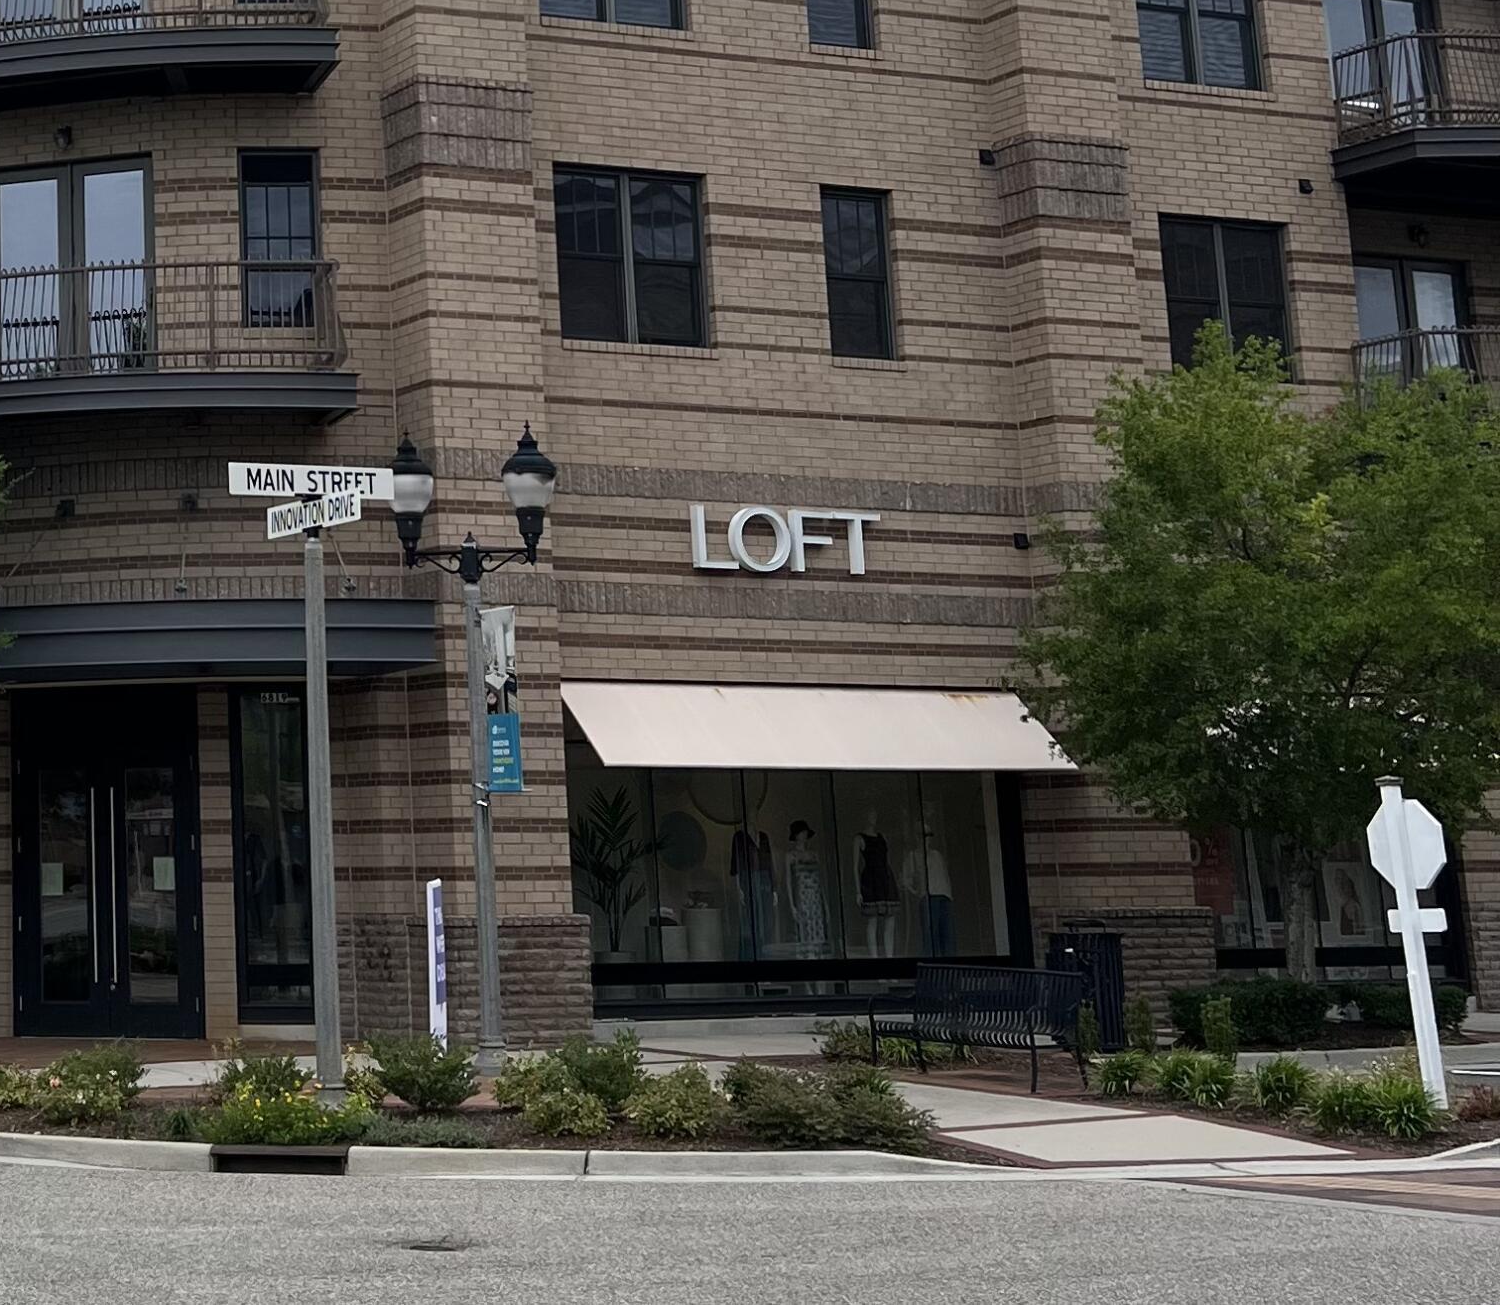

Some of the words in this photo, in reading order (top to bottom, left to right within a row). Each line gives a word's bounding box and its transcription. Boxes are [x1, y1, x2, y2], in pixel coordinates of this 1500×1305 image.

[246, 467, 294, 492] MAIN
[307, 470, 376, 495] STREET
[271, 499, 324, 534] INNOVATION
[328, 493, 355, 521] DRIVE
[689, 504, 881, 575] LOFT
